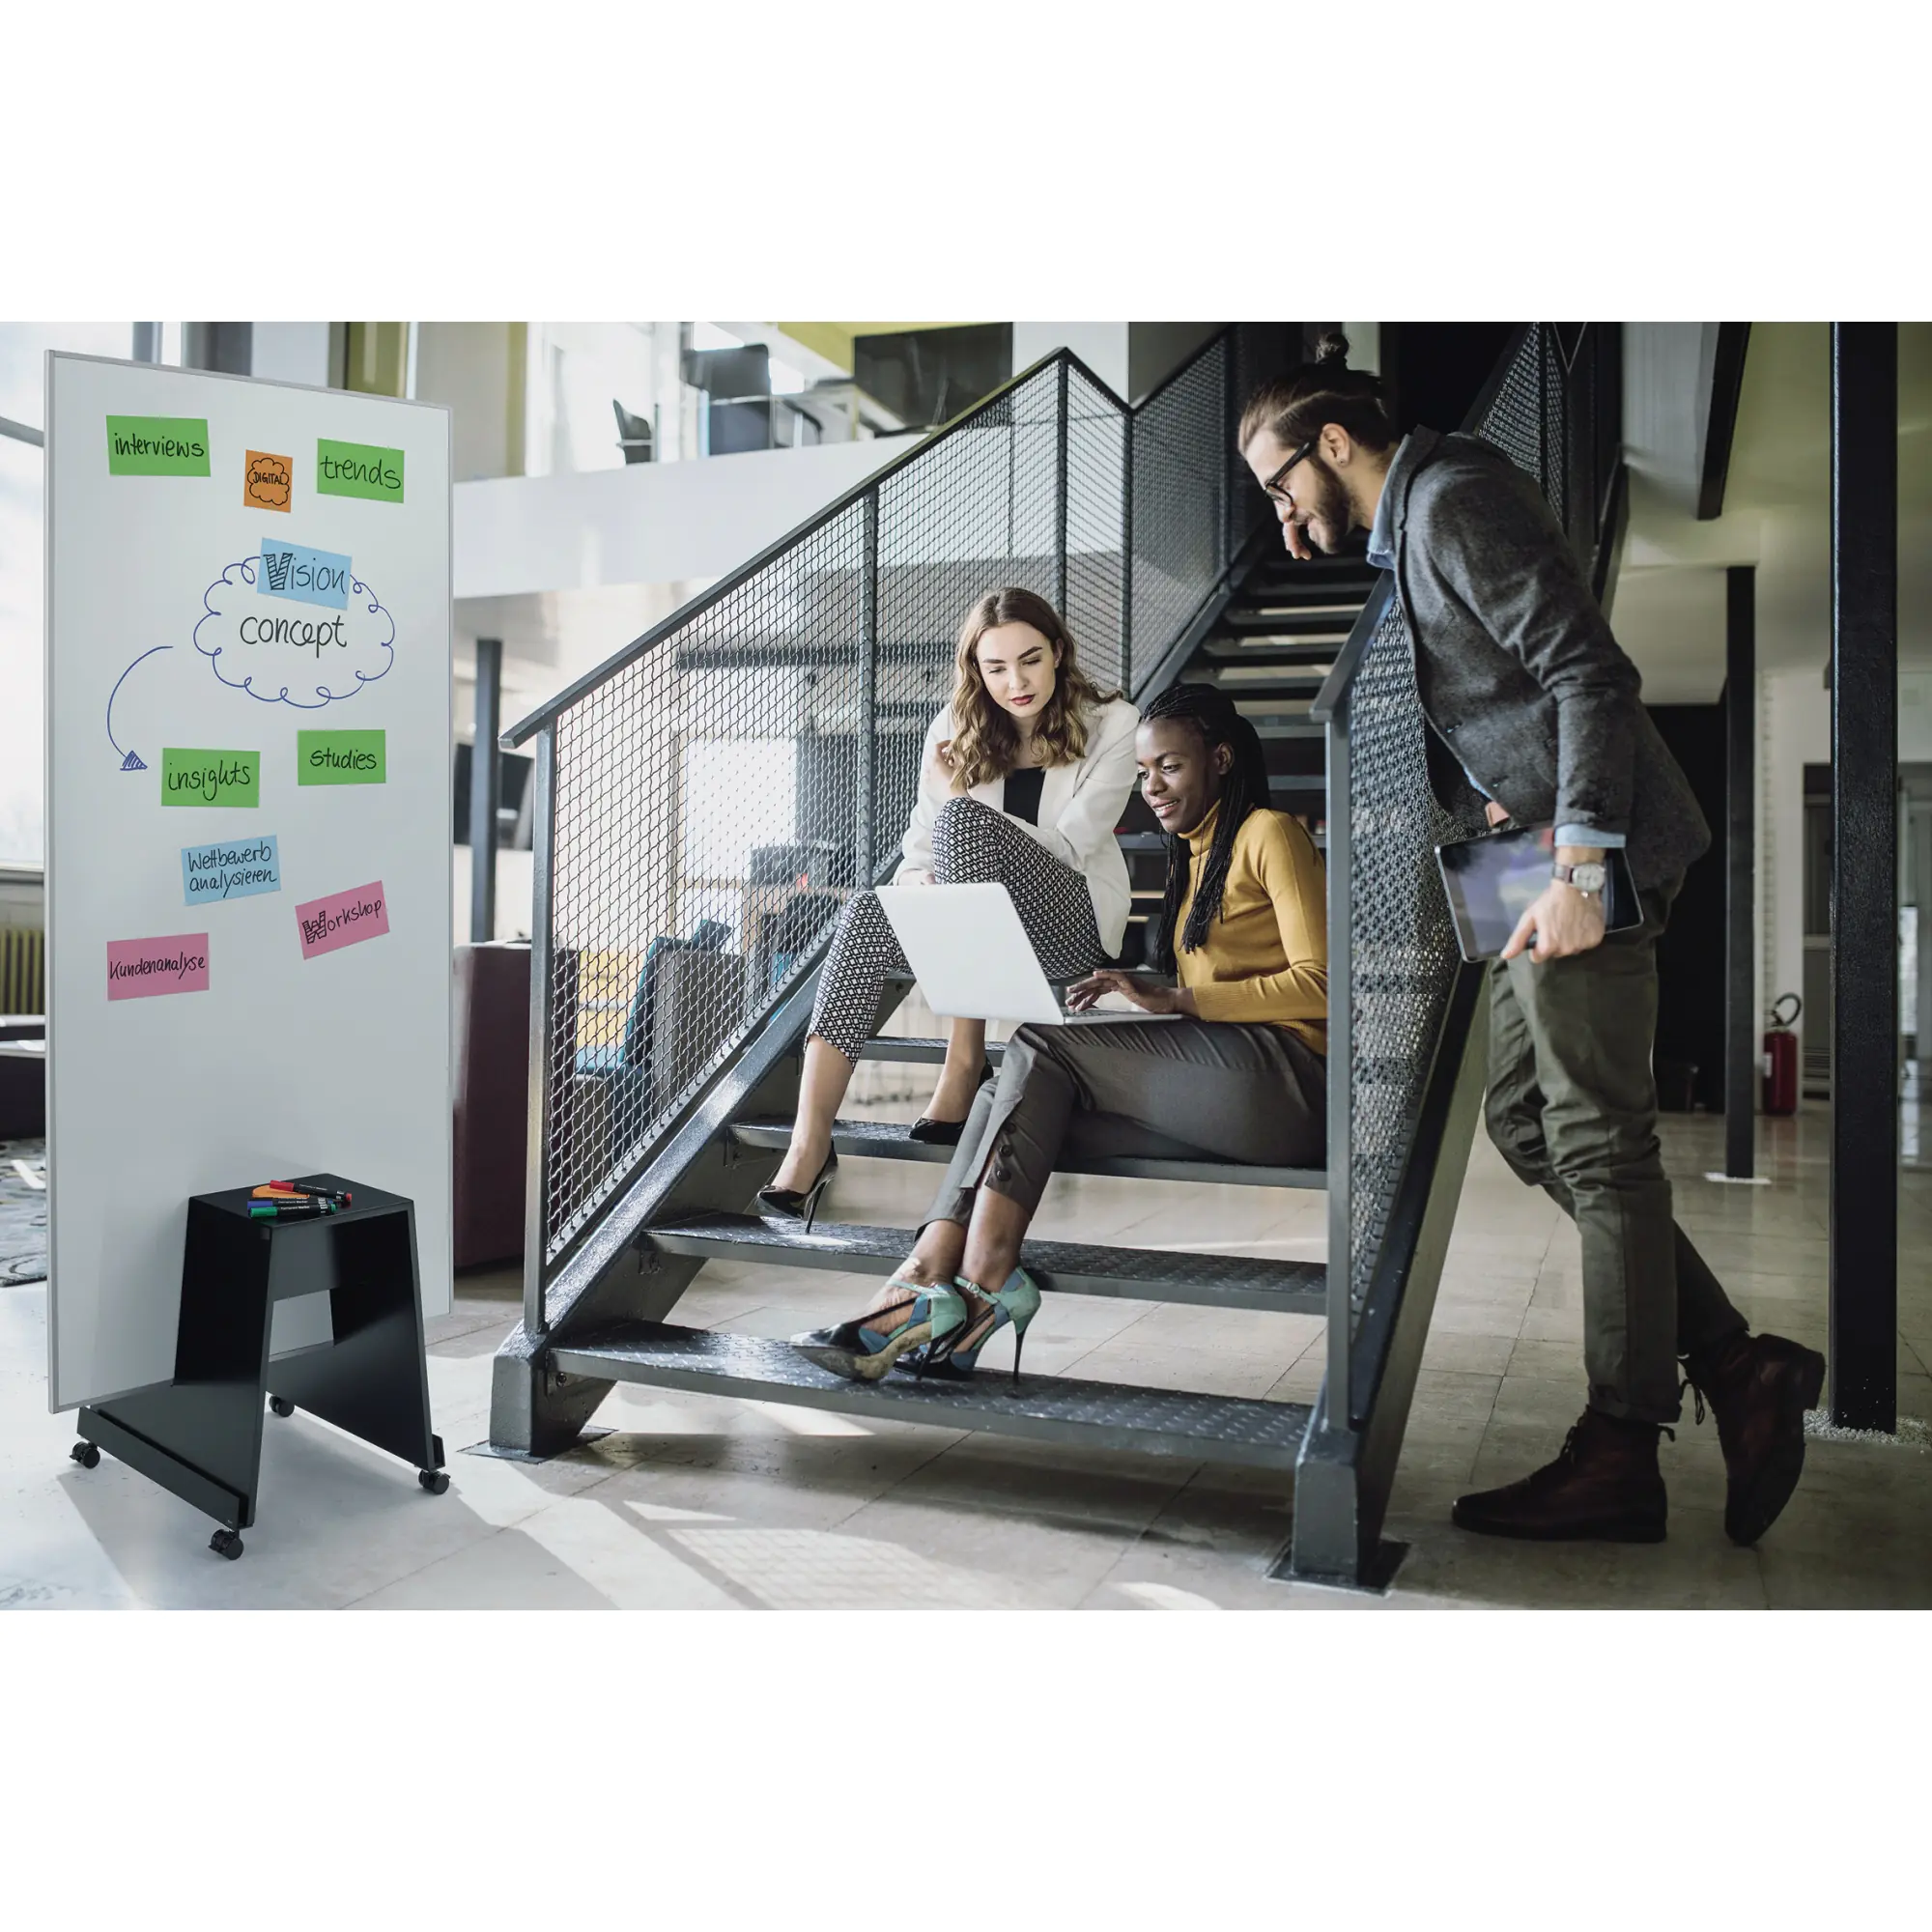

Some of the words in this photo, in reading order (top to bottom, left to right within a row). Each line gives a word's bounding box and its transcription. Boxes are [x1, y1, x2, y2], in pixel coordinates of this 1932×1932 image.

[114, 432, 205, 458] interviews
[253, 470, 283, 485] DIGITAL
[320, 455, 402, 490] trends
[263, 553, 347, 595] Vision
[240, 614, 348, 659] concept
[168, 759, 251, 802] insights
[187, 840, 272, 872] Wettbewerb
[189, 867, 277, 898] analysieren
[301, 899, 383, 945] Workshop
[109, 952, 206, 980] Kundenanalyse
